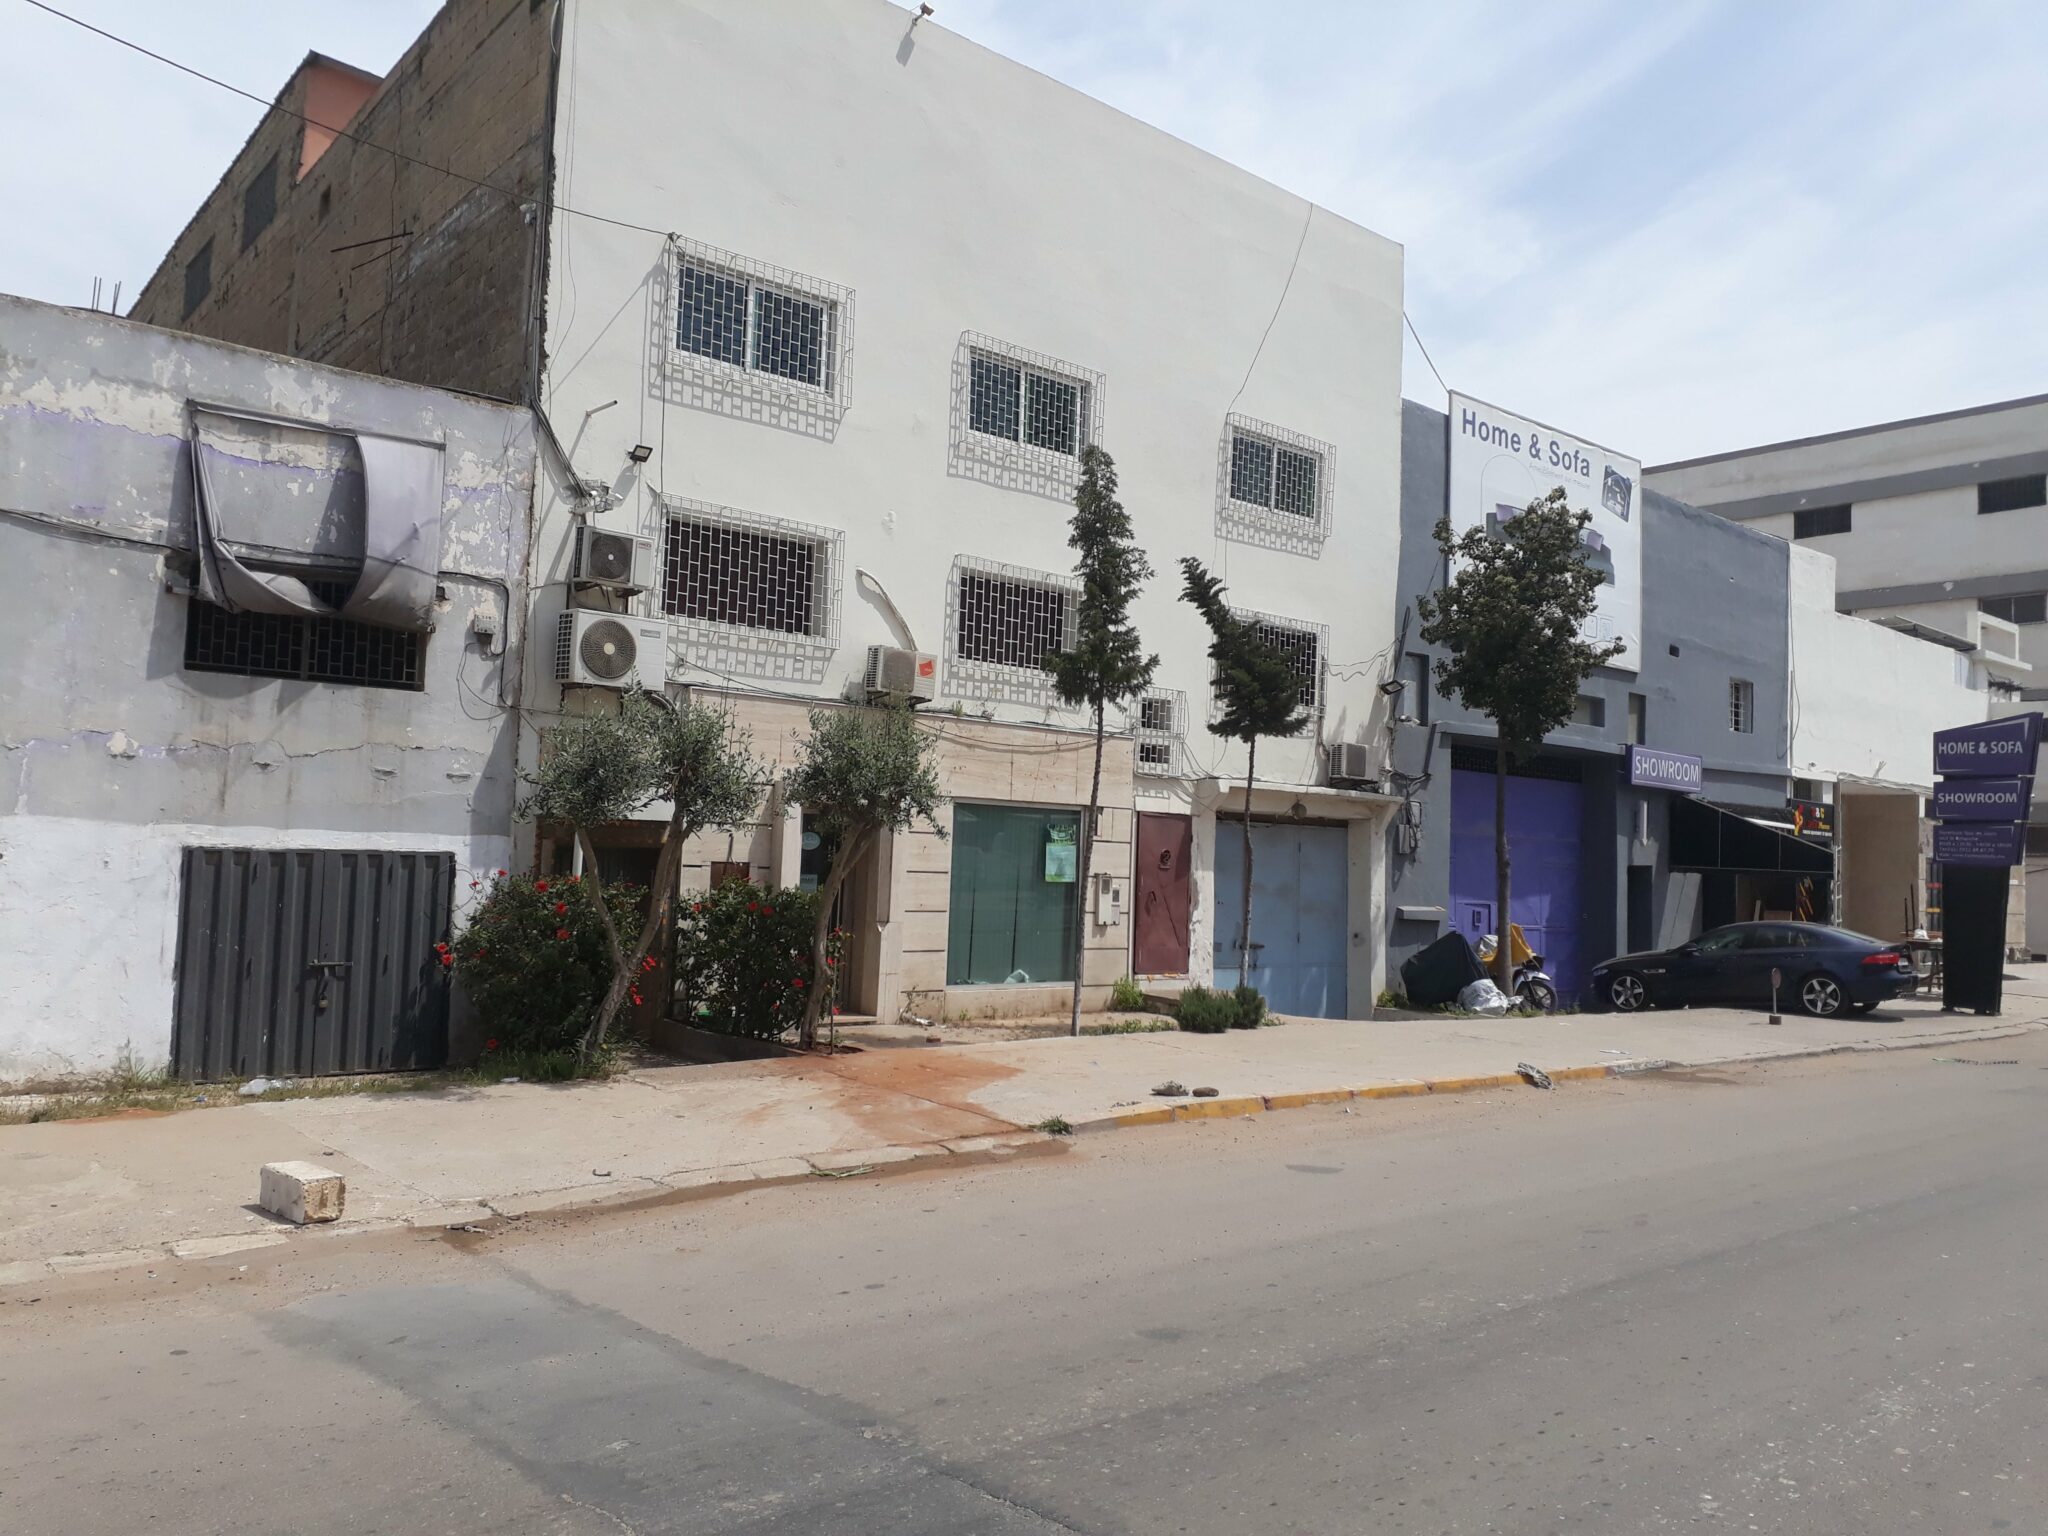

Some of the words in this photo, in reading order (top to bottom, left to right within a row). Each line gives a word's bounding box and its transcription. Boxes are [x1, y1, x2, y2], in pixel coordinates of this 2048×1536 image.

[1462, 407, 1522, 453] Home
[1528, 433, 1542, 461] &
[1548, 440, 1590, 478] Sofa
[1938, 741, 1976, 755] HOME
[1978, 741, 1988, 755] &
[1989, 741, 2024, 754] SOFA
[1635, 755, 1699, 783] SHOWROOM
[1937, 792, 2017, 804] SHOWROOM
